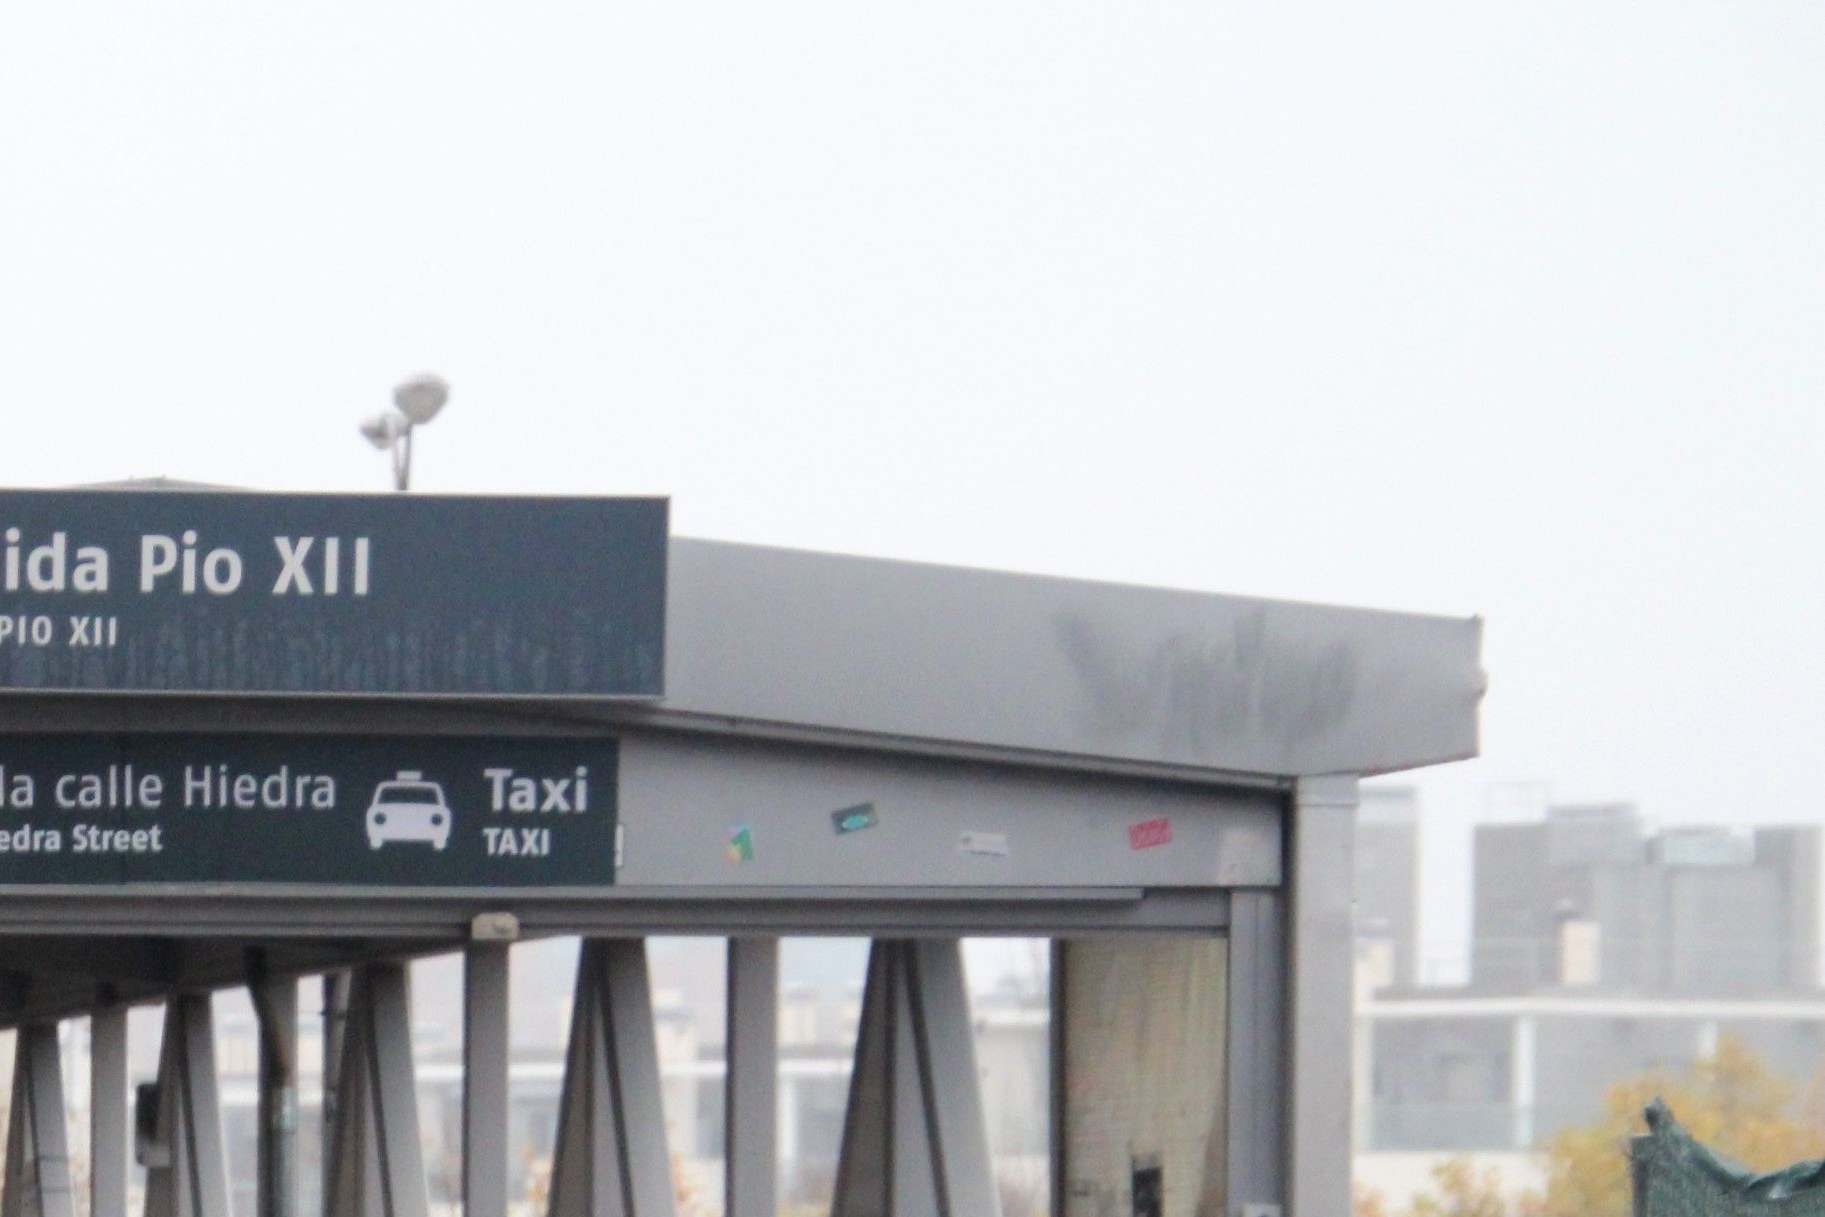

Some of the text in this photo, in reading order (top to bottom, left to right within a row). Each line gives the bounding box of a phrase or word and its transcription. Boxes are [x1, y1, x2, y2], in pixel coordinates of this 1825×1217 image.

[140, 530, 243, 595] Pio
[272, 536, 371, 596] XII
[69, 617, 118, 647] XII
[55, 765, 163, 809] calle
[185, 765, 335, 809] Hiedra
[484, 766, 588, 812] Taxi
[72, 824, 164, 853] Street
[483, 827, 551, 857] TAXI
